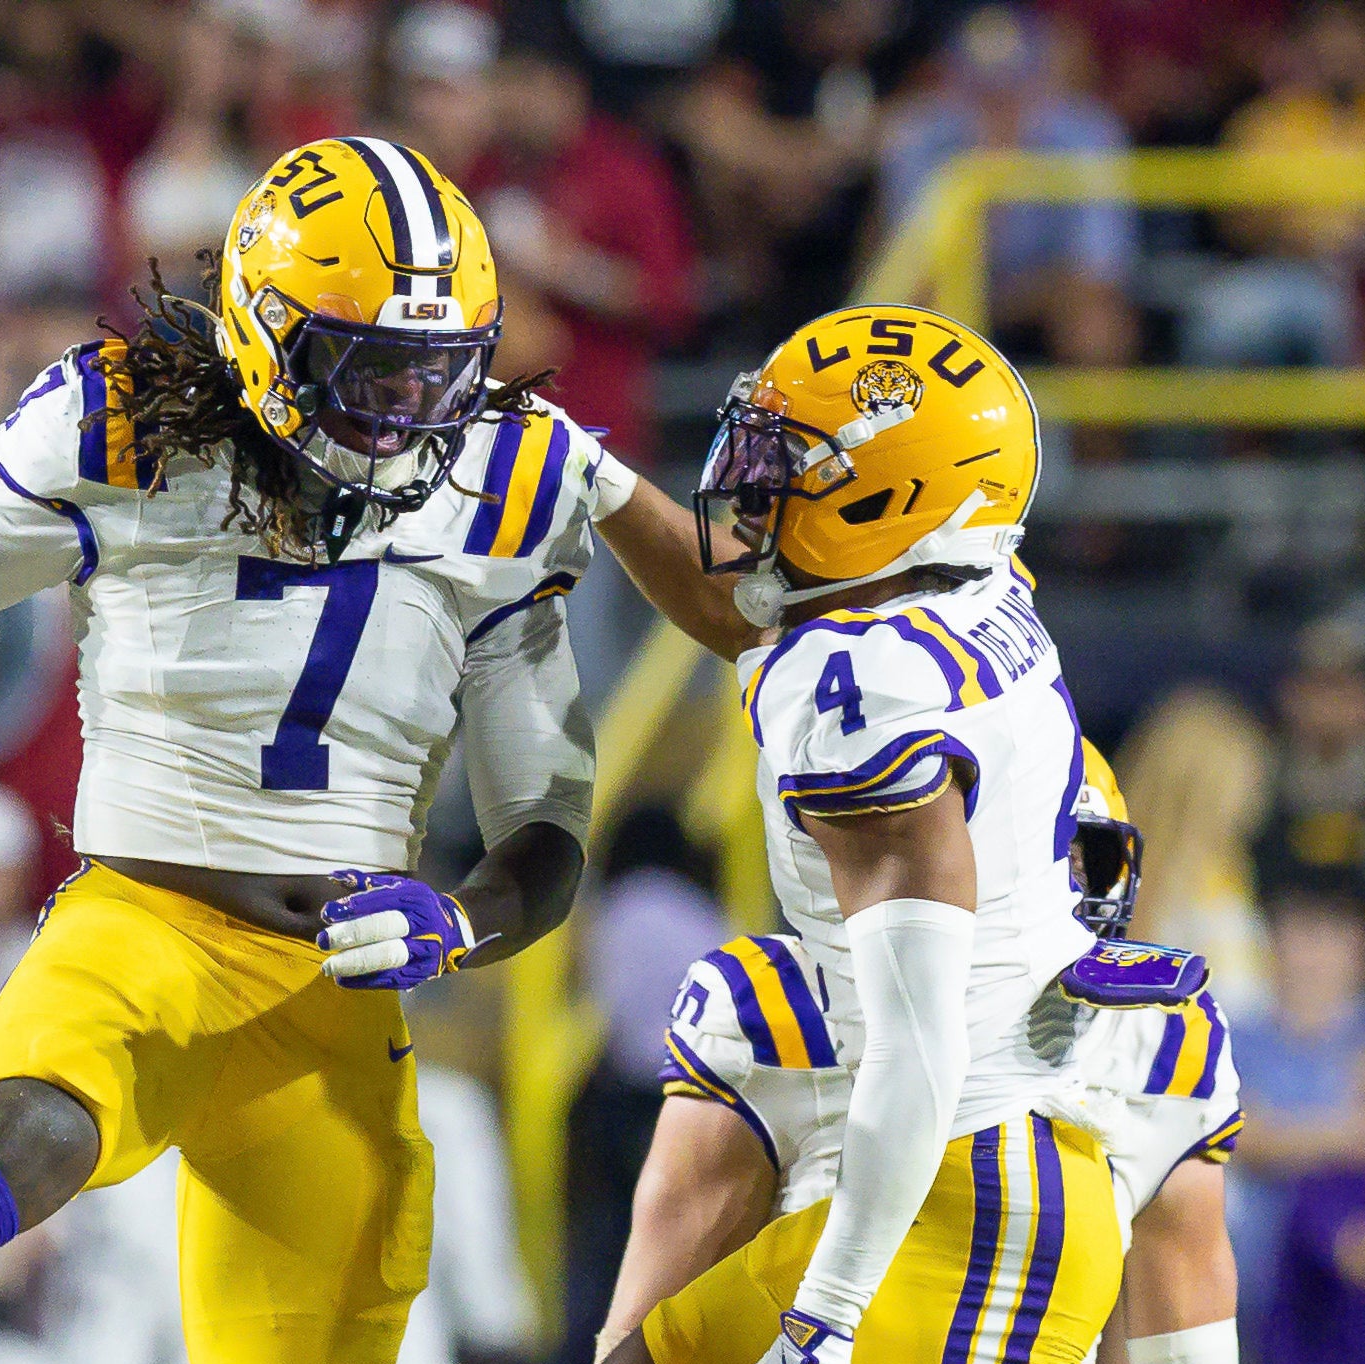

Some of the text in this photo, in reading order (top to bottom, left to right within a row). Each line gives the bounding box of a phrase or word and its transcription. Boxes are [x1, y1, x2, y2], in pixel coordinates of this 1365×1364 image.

[248, 150, 345, 219] SU
[402, 302, 448, 320] LSU
[806, 318, 986, 388] LSU
[236, 554, 379, 791] 7
[814, 650, 867, 737] 4
